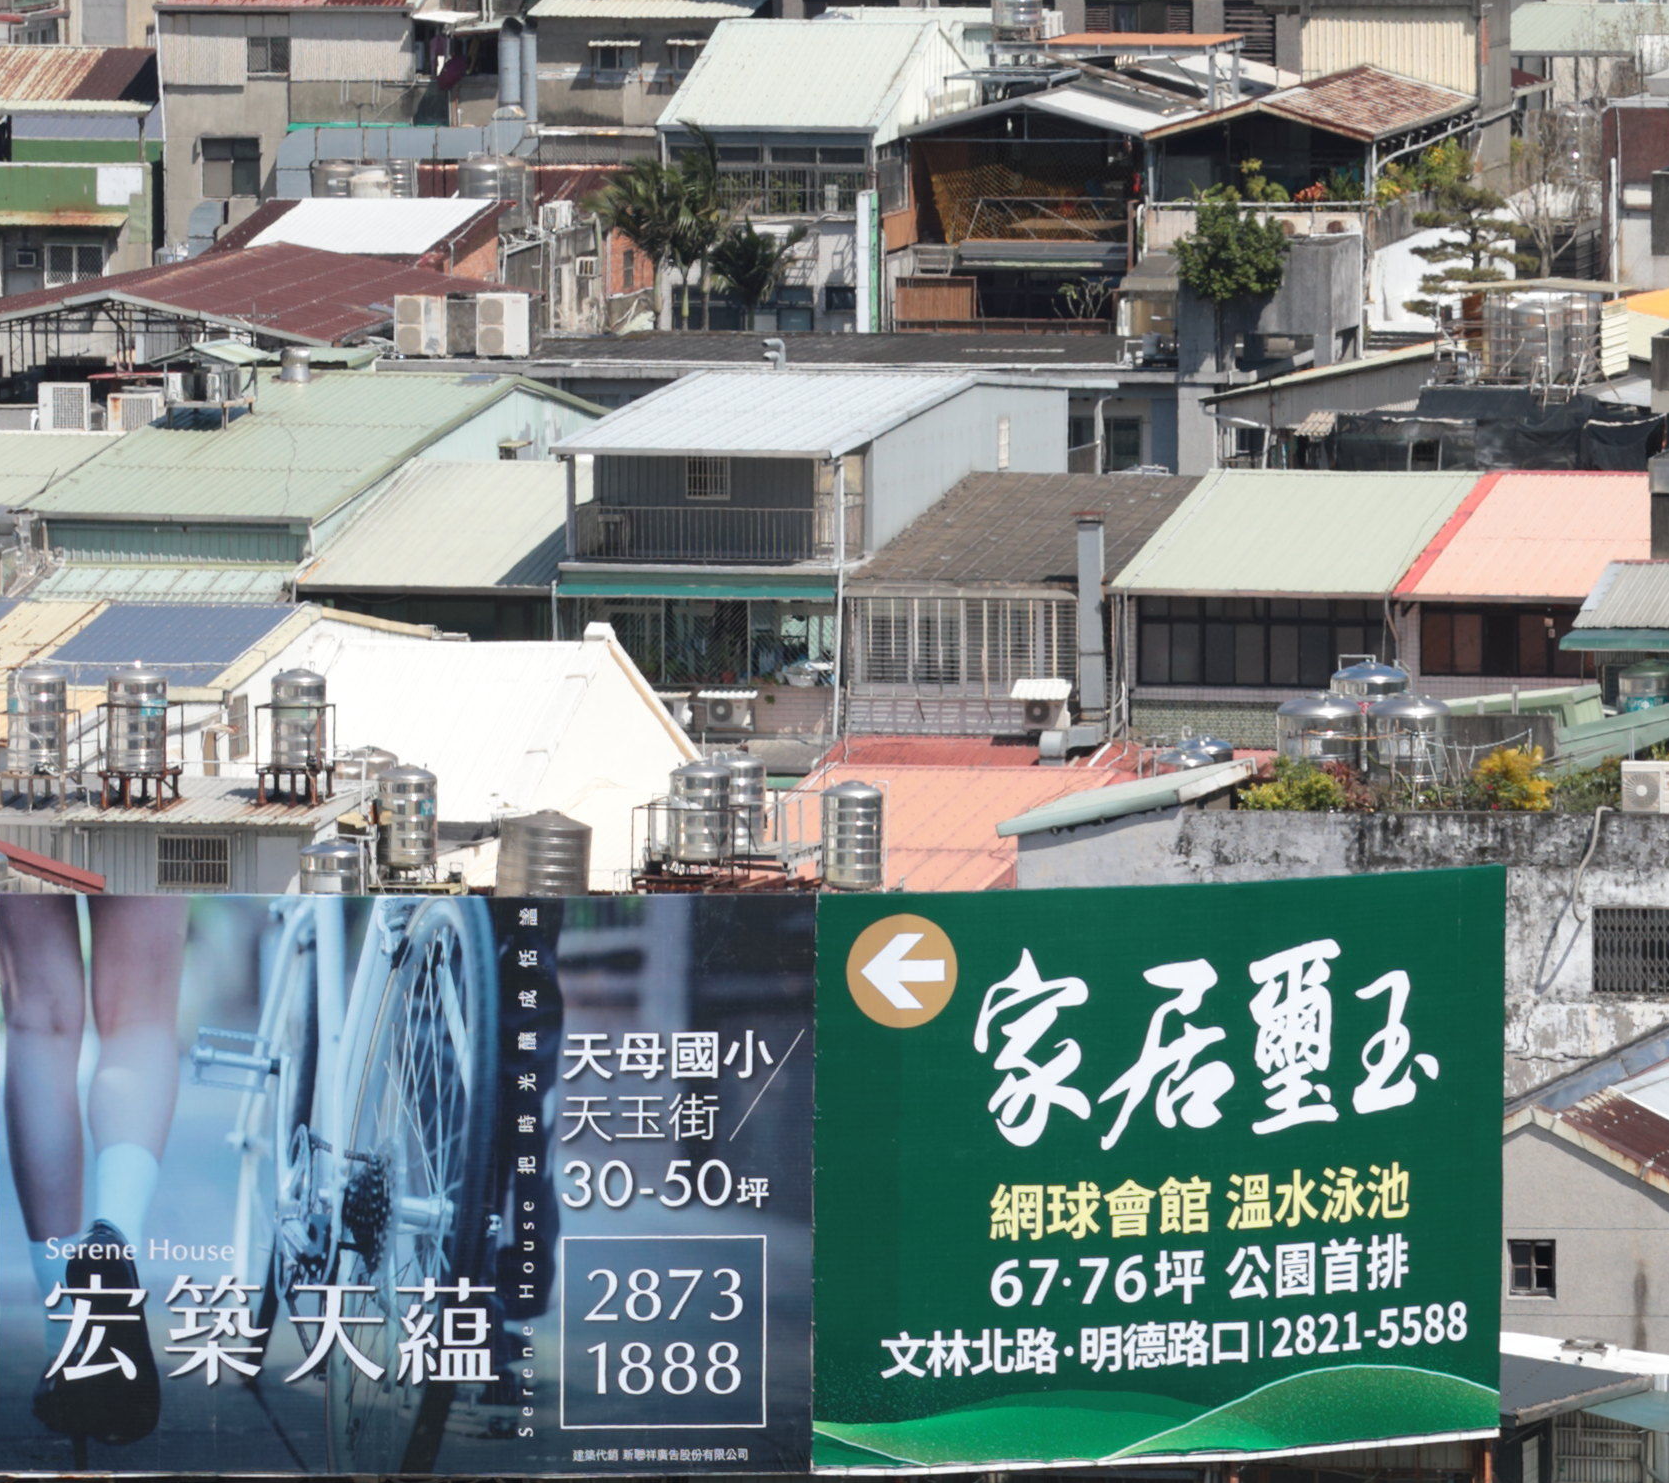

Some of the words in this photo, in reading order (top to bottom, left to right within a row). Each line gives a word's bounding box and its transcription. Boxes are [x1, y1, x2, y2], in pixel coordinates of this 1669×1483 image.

[517, 903, 538, 1178] 把時光釀成恬謐
[562, 1029, 775, 1082] 天母國小
[972, 938, 1439, 1150] 家居璽玉
[562, 1092, 721, 1143] 天玉街
[562, 1160, 770, 1212] 30-50坪
[990, 1174, 1212, 1242] 網球會館
[1225, 1161, 1410, 1232] 溫水泳池
[44, 1235, 139, 1263] Serene
[148, 1235, 237, 1263] House
[518, 1199, 537, 1299] House
[989, 1248, 1207, 1309] 67·76坪
[1225, 1235, 1410, 1299] 公園首排
[44, 1273, 501, 1386] 宏築天蘊
[586, 1268, 744, 1322] 2873
[586, 1341, 743, 1396] 1888
[880, 1319, 1252, 1382] 文林北路·明德路口
[1270, 1302, 1468, 1359] 2821-5588
[518, 1323, 537, 1439] Serene
[572, 1447, 619, 1462] 建築代銷
[622, 1447, 749, 1463] 新聯祥廣告股份有限公司
